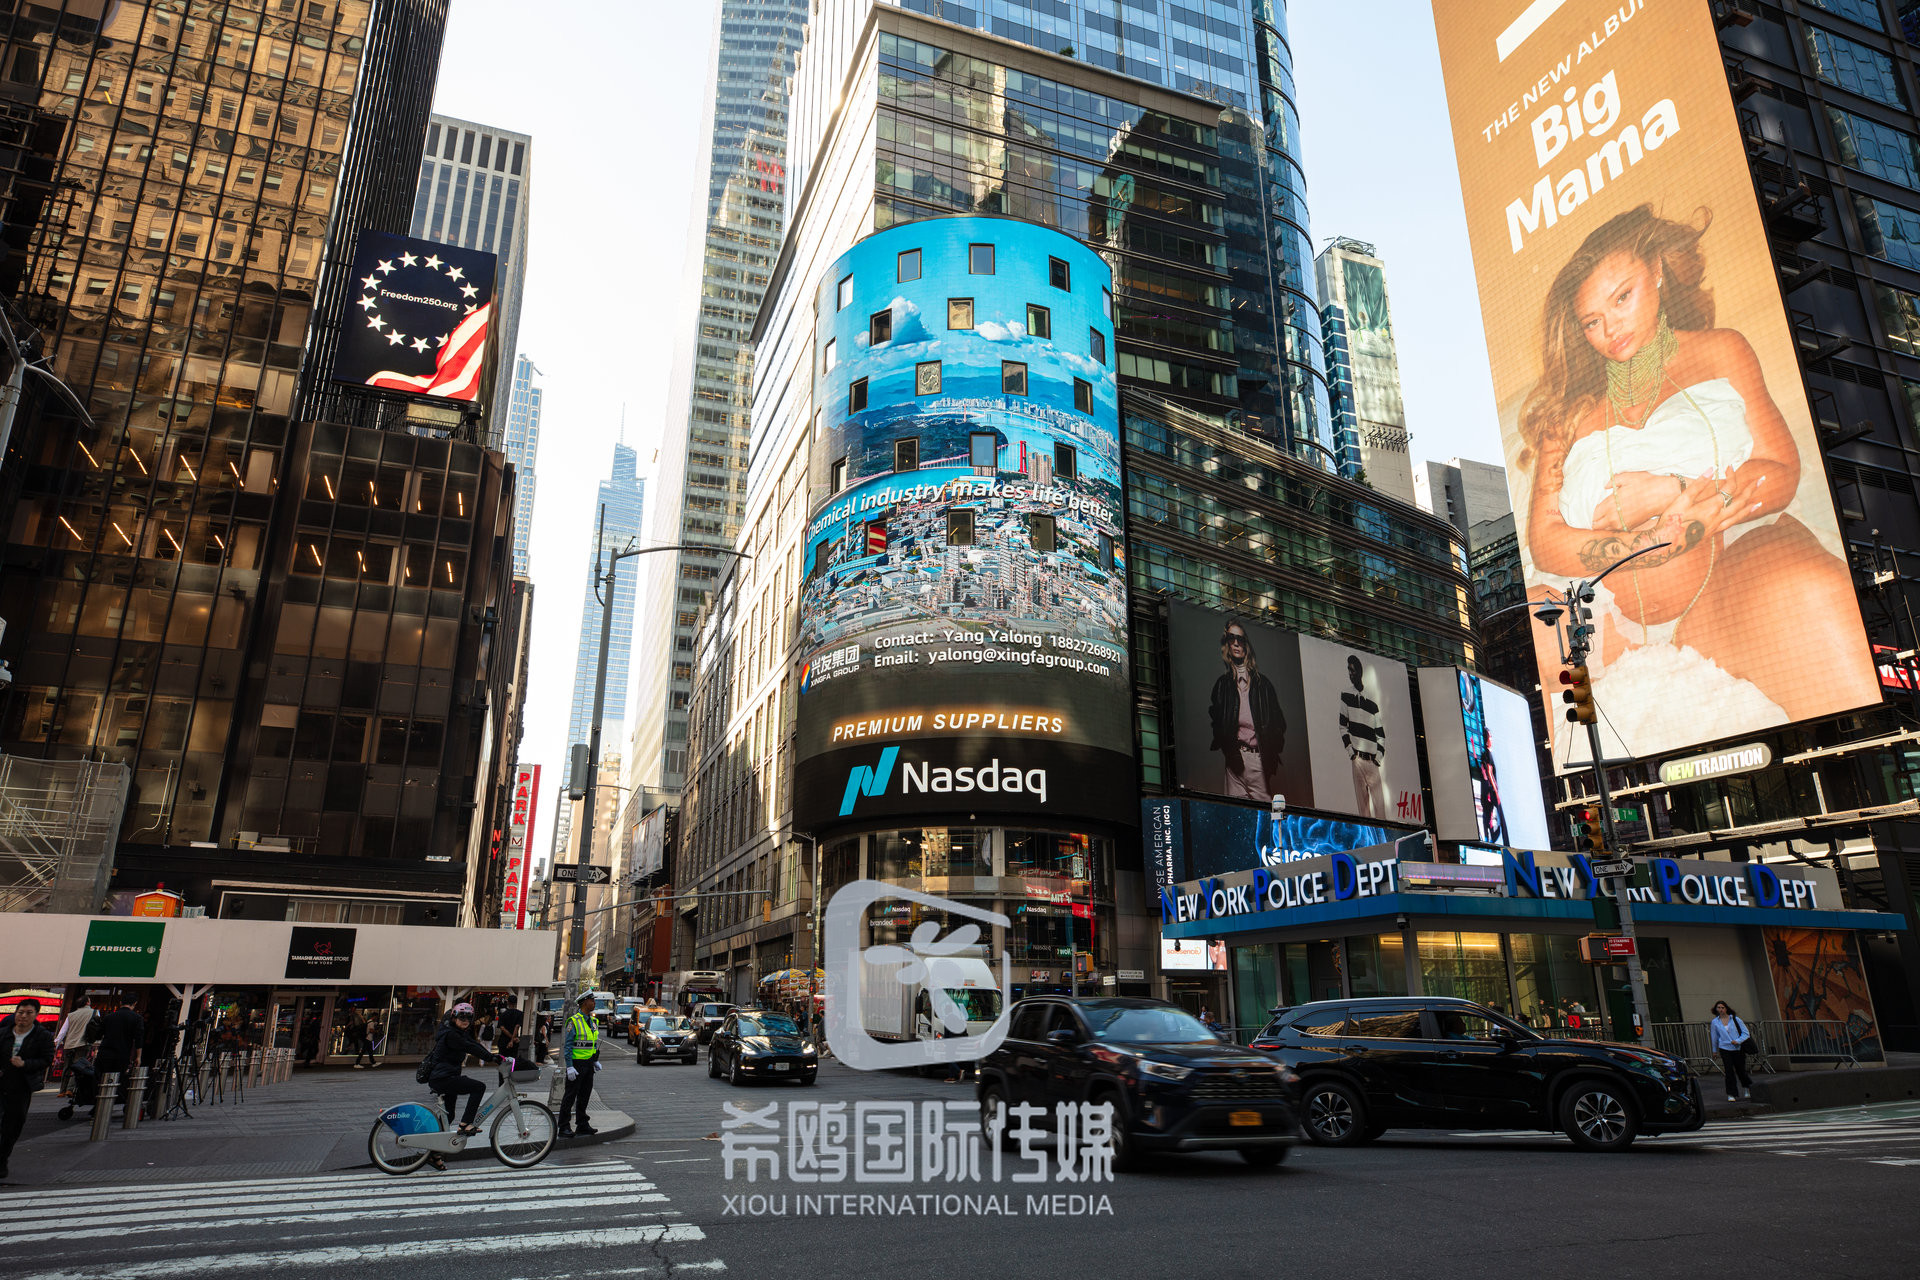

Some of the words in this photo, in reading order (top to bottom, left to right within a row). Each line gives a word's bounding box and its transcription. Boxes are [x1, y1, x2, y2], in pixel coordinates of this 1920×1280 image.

[1482, 101, 1520, 143] THE
[1523, 54, 1571, 110] NEW
[1531, 69, 1621, 169] Big
[1505, 98, 1680, 255] Mama
[380, 289, 459, 311] Freedom250.org
[807, 498, 855, 543] Chemical
[861, 485, 942, 513] industry
[951, 483, 1025, 500] makes
[1033, 485, 1062, 507] life
[1069, 491, 1114, 524] better
[811, 644, 859, 678] 兴发集团
[874, 632, 934, 650] Contact:
[943, 630, 984, 647] Yang
[989, 630, 1041, 648] Yalong
[1051, 635, 1121, 664] 18827268921
[874, 652, 919, 668] Email:
[928, 648, 1110, 677] yalong@xingfagroup.com
[810, 673, 831, 688] XINGFA
[833, 665, 860, 678] GROUP
[833, 715, 923, 742] PREMIUM
[933, 713, 1063, 733] SUPPLIERS
[902, 759, 1047, 803] Nasdaq
[514, 772, 531, 825] PARK
[1397, 791, 1422, 822] H&M
[492, 829, 501, 860] NY
[1153, 806, 1164, 867] AMERICAN
[1164, 828, 1172, 844] INC.
[503, 857, 521, 912] PARK
[561, 869, 577, 878] ONE
[1502, 849, 1576, 899] NEW
[1656, 858, 1749, 906] POLICE
[1751, 864, 1817, 909] DEPT
[1595, 866, 1608, 874] ONE
[1615, 863, 1629, 871] WAY
[1160, 885, 1199, 924] NEW
[1199, 877, 1250, 919] YORK
[1253, 868, 1325, 912] POLICE
[1332, 853, 1397, 900] DEPT
[1026, 906, 1047, 914] Nasdaq
